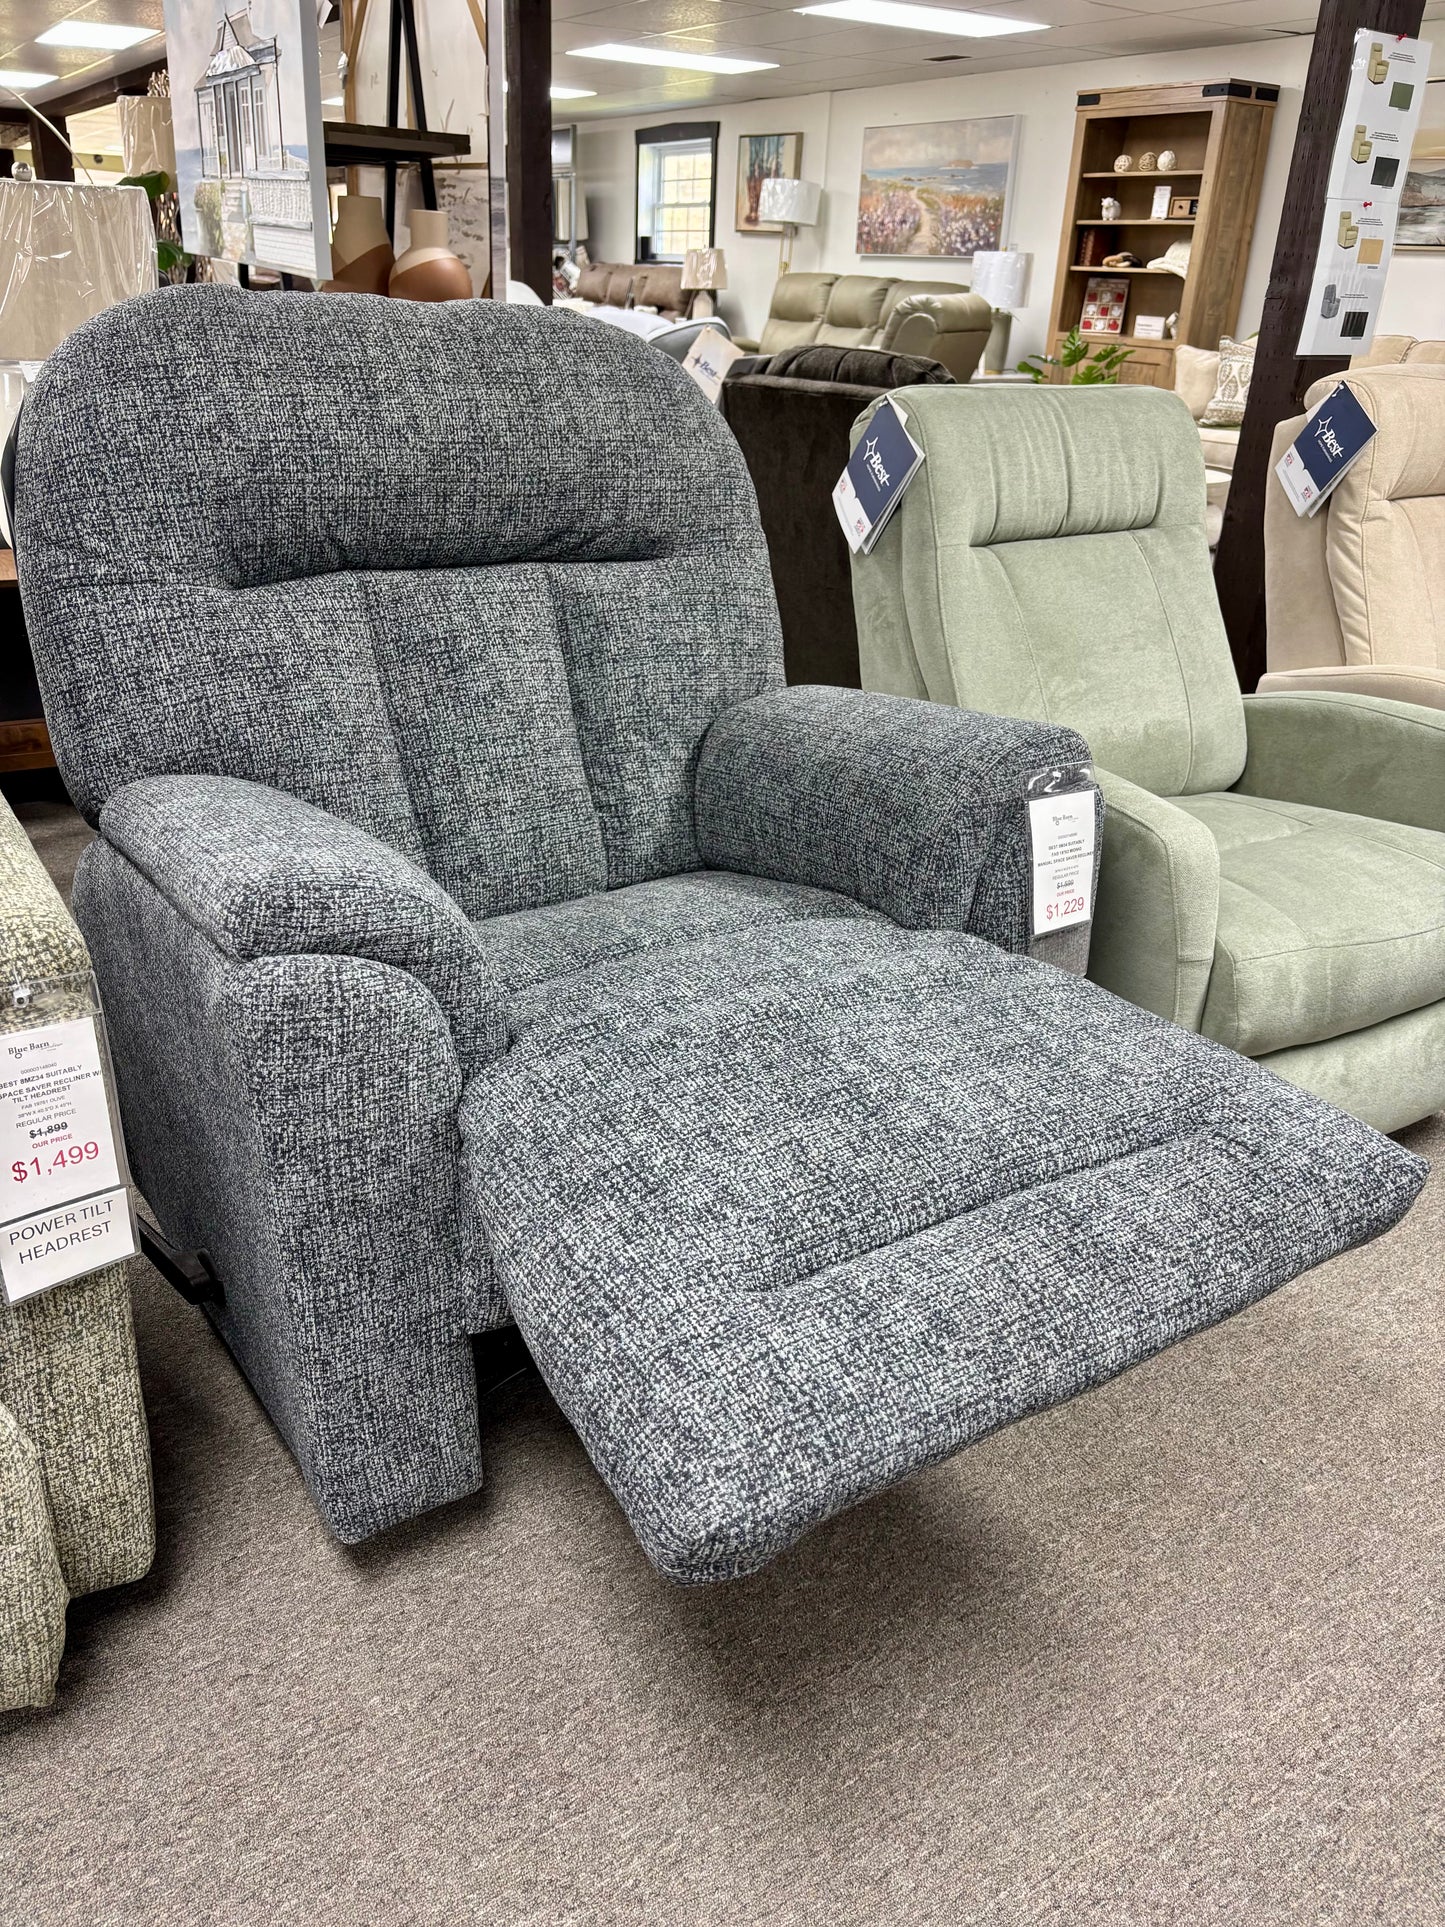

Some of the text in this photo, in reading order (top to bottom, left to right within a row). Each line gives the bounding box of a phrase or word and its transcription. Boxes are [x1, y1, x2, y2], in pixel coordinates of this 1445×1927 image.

[1321, 428, 1344, 458] Best
[869, 451, 890, 487] Best
[1046, 896, 1085, 920] $1,229
[8, 1046, 28, 1055] Blue
[29, 1041, 50, 1050] Barn
[0, 1080, 18, 1089] BEST
[45, 1064, 82, 1078] SUITABLY
[25, 1082, 52, 1093] SAVER
[53, 1072, 91, 1086] RECLINER
[12, 1084, 71, 1104] TILT HEADREST
[16, 1108, 77, 1128] REGULAR PRICE
[29, 1121, 68, 1139] $1,899
[32, 1133, 73, 1149] OUR PRICE
[11, 1141, 99, 1183] $1,499
[9, 1200, 114, 1245] POWER TILT
[19, 1220, 112, 1264] HEADREST
